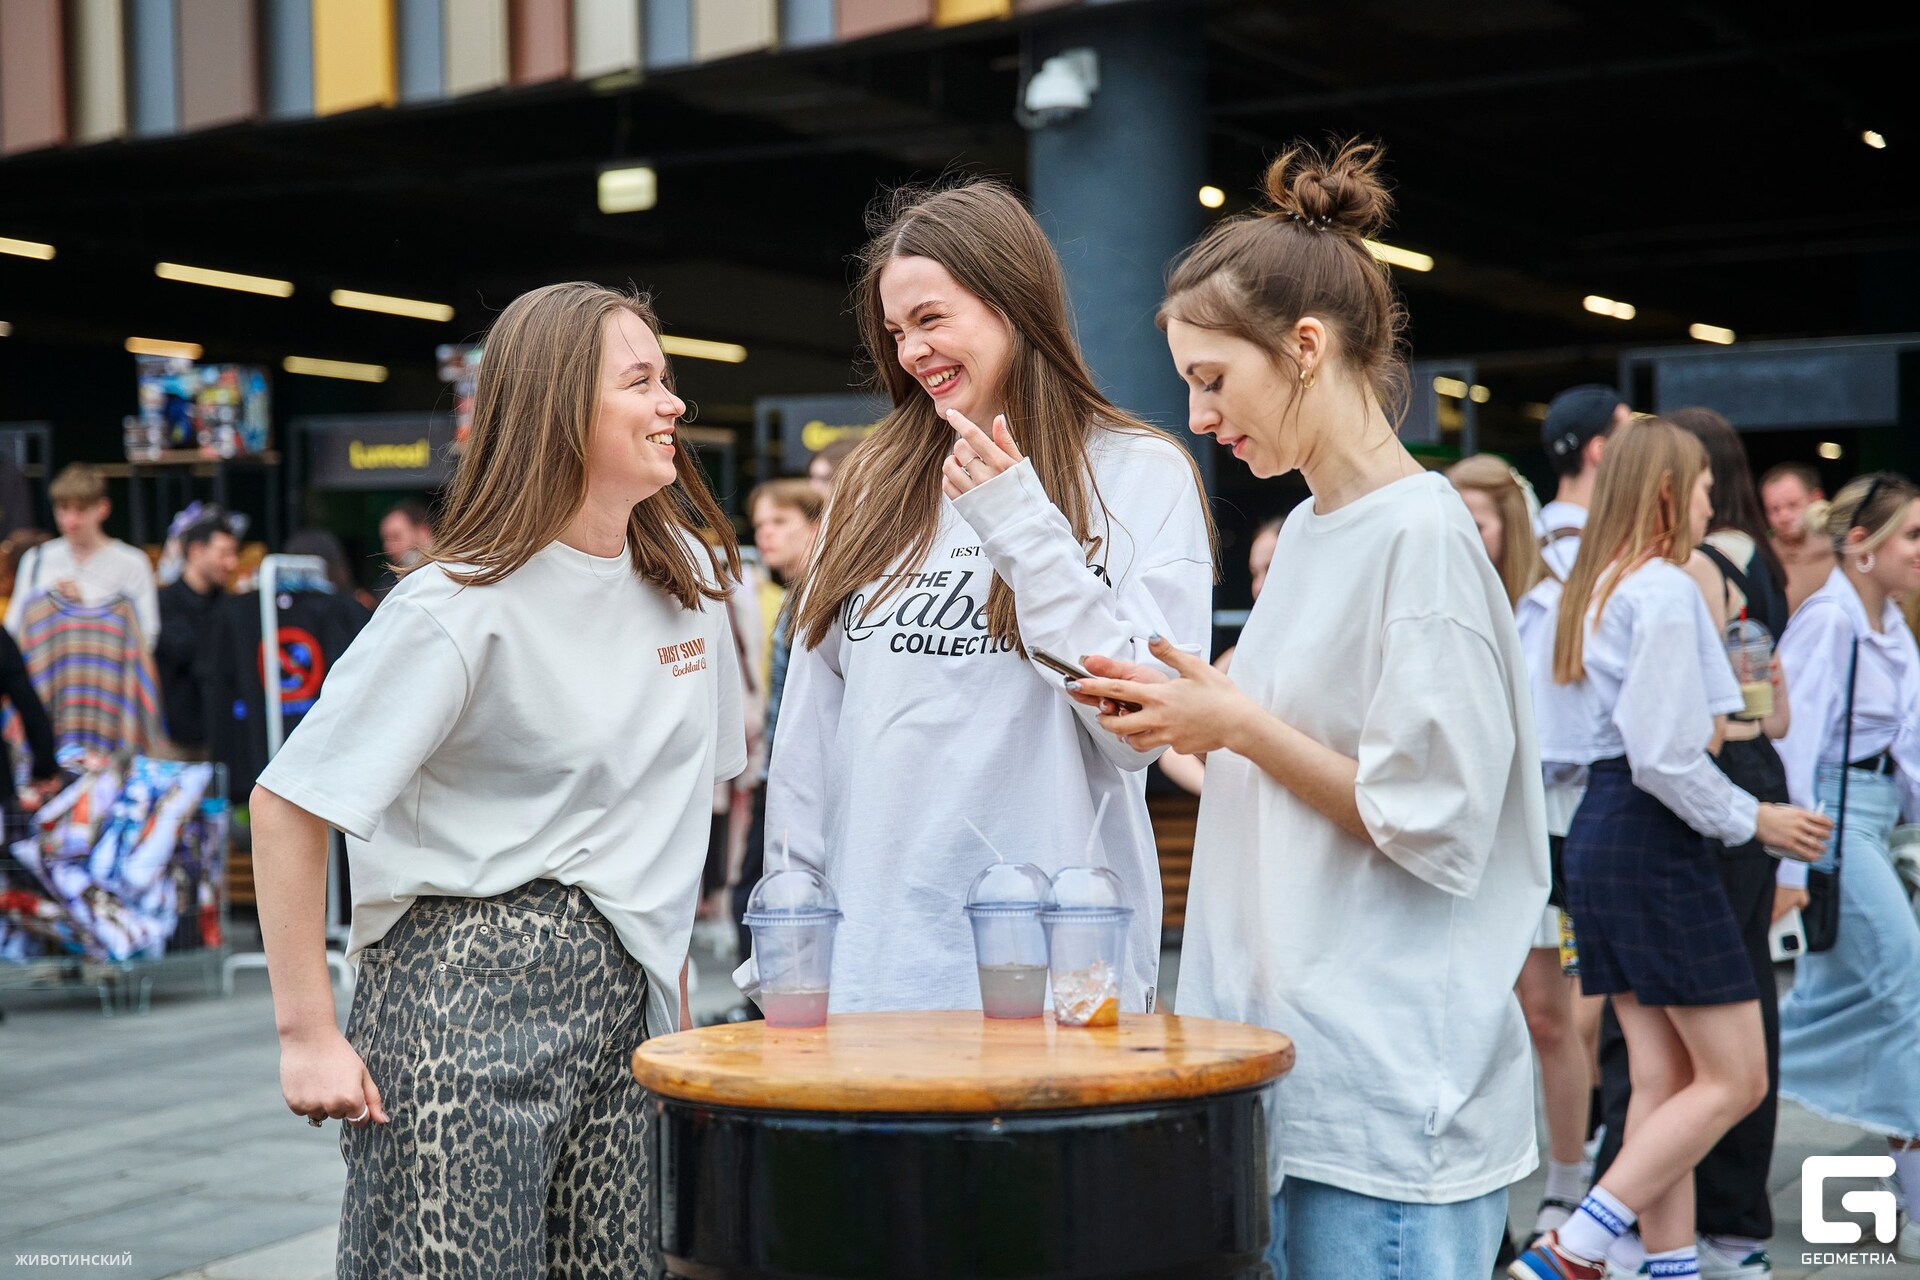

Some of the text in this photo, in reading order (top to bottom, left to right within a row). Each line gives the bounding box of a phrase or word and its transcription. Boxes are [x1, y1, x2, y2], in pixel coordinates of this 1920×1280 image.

[905, 571, 951, 589] THE
[890, 632, 1018, 656] COLLECTIO
[672, 659, 700, 677] Cocktail
